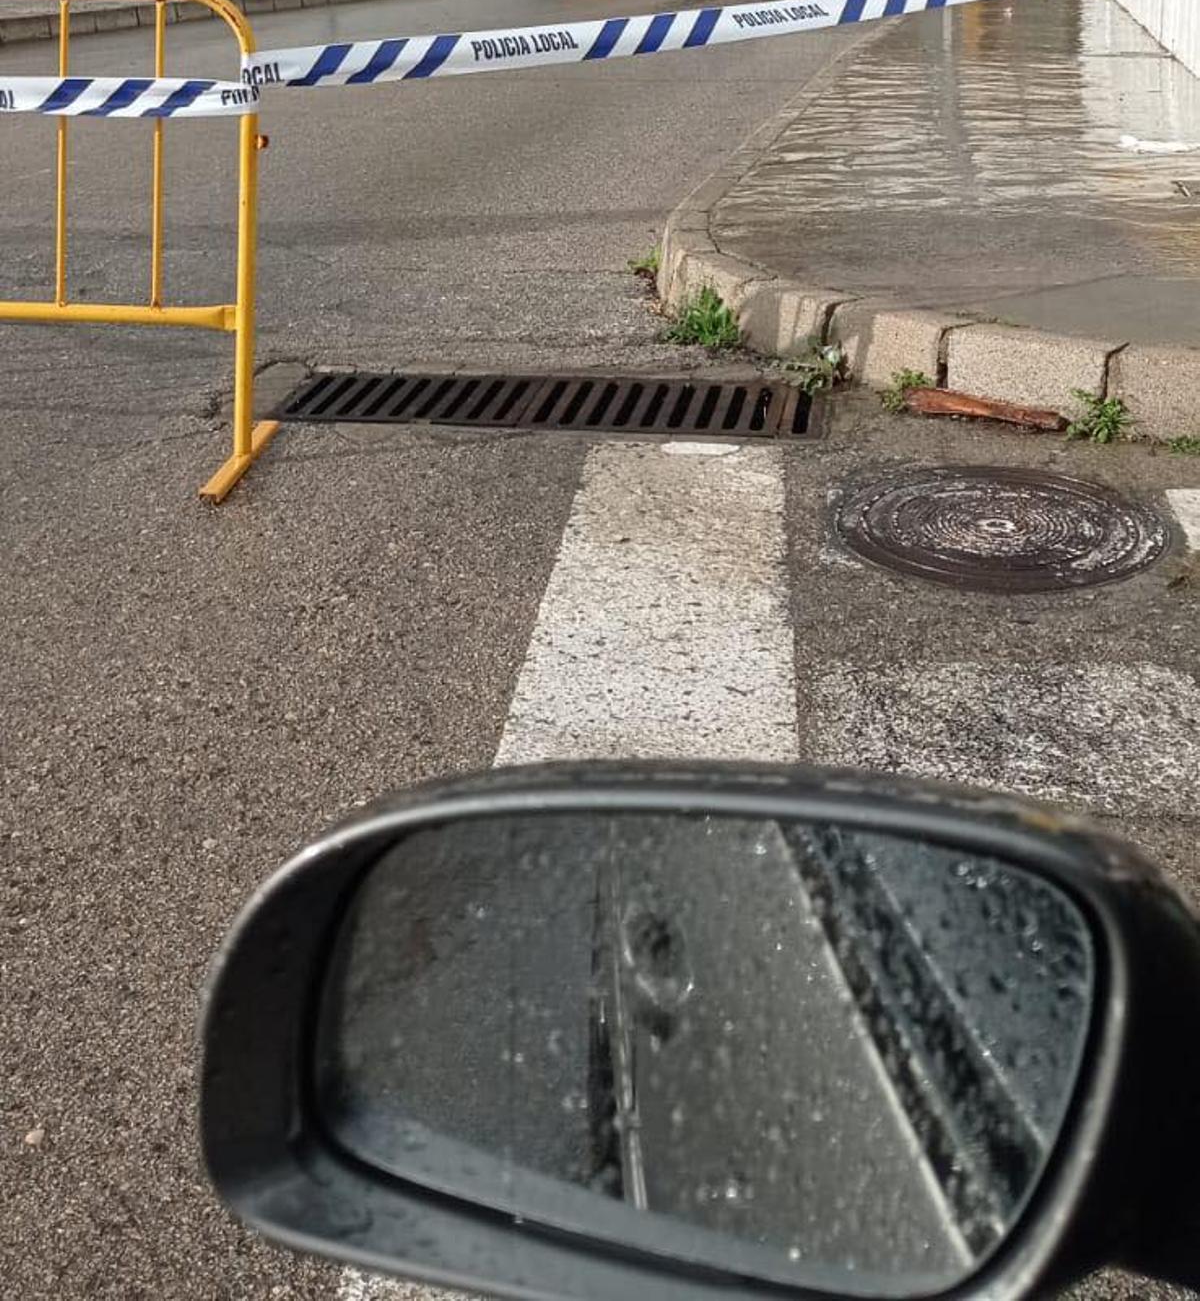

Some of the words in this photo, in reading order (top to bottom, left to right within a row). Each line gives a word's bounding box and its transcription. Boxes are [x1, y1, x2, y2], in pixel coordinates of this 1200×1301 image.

[732, 7, 788, 28] POLICIA
[783, 3, 830, 20] LOCAL
[471, 35, 531, 60] POLICIA
[530, 31, 579, 53] LOCAL
